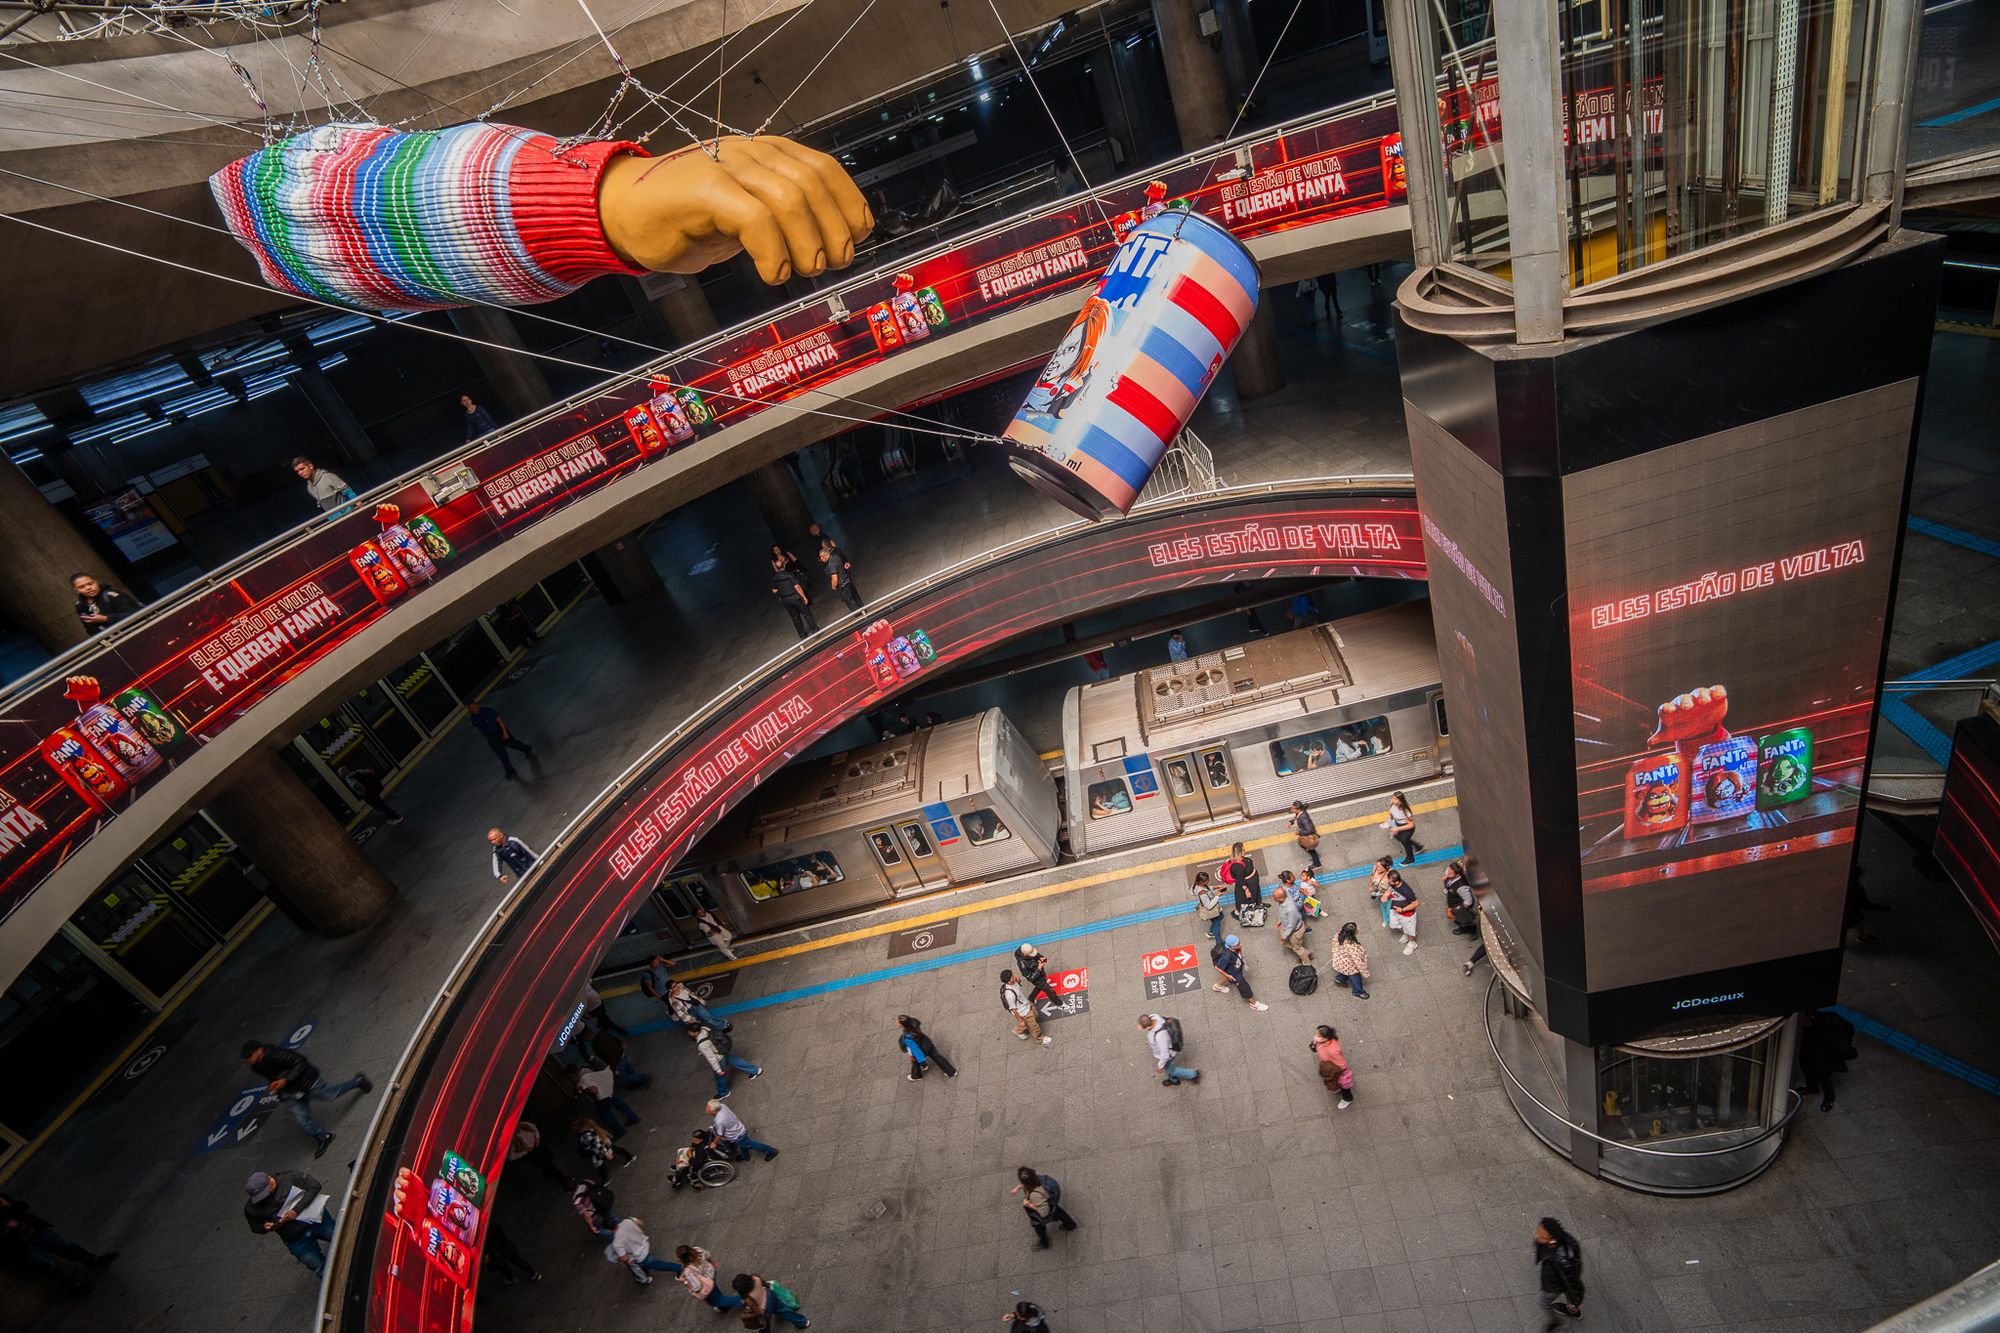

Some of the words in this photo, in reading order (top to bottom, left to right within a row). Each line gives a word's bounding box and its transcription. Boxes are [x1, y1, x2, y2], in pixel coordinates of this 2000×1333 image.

[1385, 142, 1402, 156] FANT
[1221, 183, 1248, 201] ELES
[1248, 170, 1285, 194] ESTÃO
[1285, 166, 1302, 184] DE
[1301, 156, 1341, 179] VOLTA
[1223, 202, 1234, 222] E
[1235, 186, 1295, 217] QUEREM
[1296, 173, 1346, 200] FANTA
[977, 264, 1002, 282] ELES
[1001, 252, 1034, 274] ESTÃO
[1033, 247, 1048, 262] DE
[1047, 236, 1081, 256] VOLTA
[981, 283, 992, 300] E
[991, 264, 1045, 295] QUEREM
[1044, 250, 1088, 276] FANTA
[870, 309, 889, 322] FANTA
[727, 363, 753, 382] ELES
[751, 349, 784, 373] ESTÃO
[782, 343, 798, 360] DE
[796, 331, 830, 353] VOLTA
[732, 383, 745, 398] E
[743, 360, 797, 393] QUEREM
[795, 344, 839, 371] FANTA
[629, 411, 648, 427] FANTA
[484, 475, 514, 498] ELES
[510, 458, 547, 484] ESTÃO
[544, 450, 561, 468] DE
[559, 435, 596, 460] VOLTA
[1066, 457, 1082, 472] ml
[492, 498, 507, 517] E
[503, 469, 563, 509] QUEREM
[559, 448, 608, 480] FANTA
[386, 533, 408, 551] FANTA
[413, 521, 433, 537] FANTA
[355, 550, 379, 568] FANTA
[1148, 537, 1204, 567] ELES
[1205, 523, 1280, 558] ESTÃO
[1282, 525, 1317, 550] DE
[1318, 523, 1400, 550] VOLTA
[1592, 595, 1650, 629] ELES
[1655, 572, 1736, 613] ESTÃO
[1741, 563, 1775, 592] DE
[1780, 540, 1865, 581] VOLTA
[188, 639, 227, 670] ELES
[220, 616, 267, 650] ESTÃO
[261, 603, 284, 624] DE
[278, 581, 324, 613] VOLTA
[202, 668, 225, 693] E
[216, 625, 289, 682] QUEREM
[282, 596, 341, 639] FANTA
[122, 696, 148, 718] FANTA
[88, 712, 117, 738] FANTA
[50, 738, 82, 765] FANTA
[1702, 748, 1748, 772] FANTA
[1764, 738, 1806, 760] FANTA
[608, 818, 662, 880] ELES
[654, 767, 721, 831] ESTÃO
[715, 738, 749, 776] DE
[742, 695, 813, 751] VOLTA
[1635, 763, 1679, 786] FANTA
[0, 804, 47, 854] NTA
[1151, 980, 1159, 994] Exit
[1672, 991, 1745, 1010] JCDecaux
[1076, 995, 1084, 1009] Exit
[558, 1002, 585, 1047] JCDecaux
[446, 1157, 458, 1182] FANTA
[436, 1187, 449, 1216] FANTA
[427, 1227, 439, 1256] FANTA
